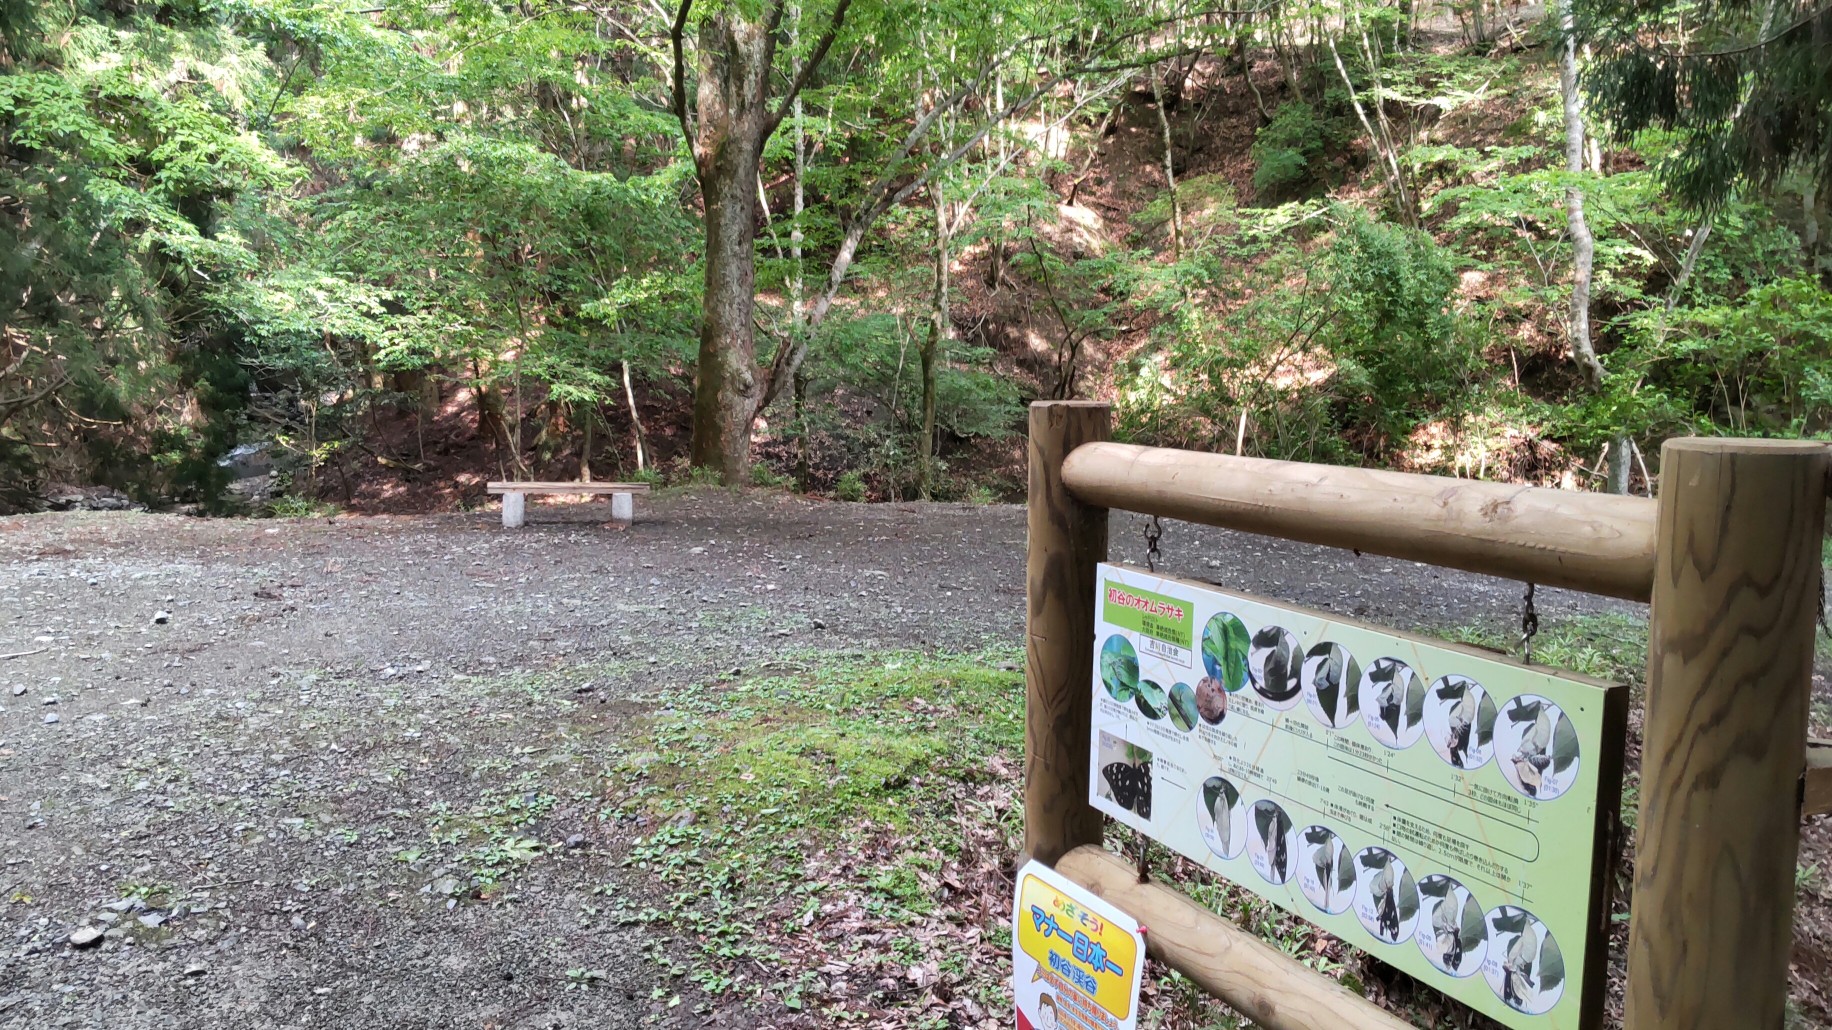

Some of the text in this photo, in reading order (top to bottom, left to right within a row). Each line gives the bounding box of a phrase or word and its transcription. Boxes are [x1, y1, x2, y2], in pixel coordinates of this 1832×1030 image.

[1108, 587, 1184, 622] 初谷のオオムラサキ
[1030, 904, 1123, 977] マナー日本一
[1048, 949, 1098, 996] 初谷渓谷
